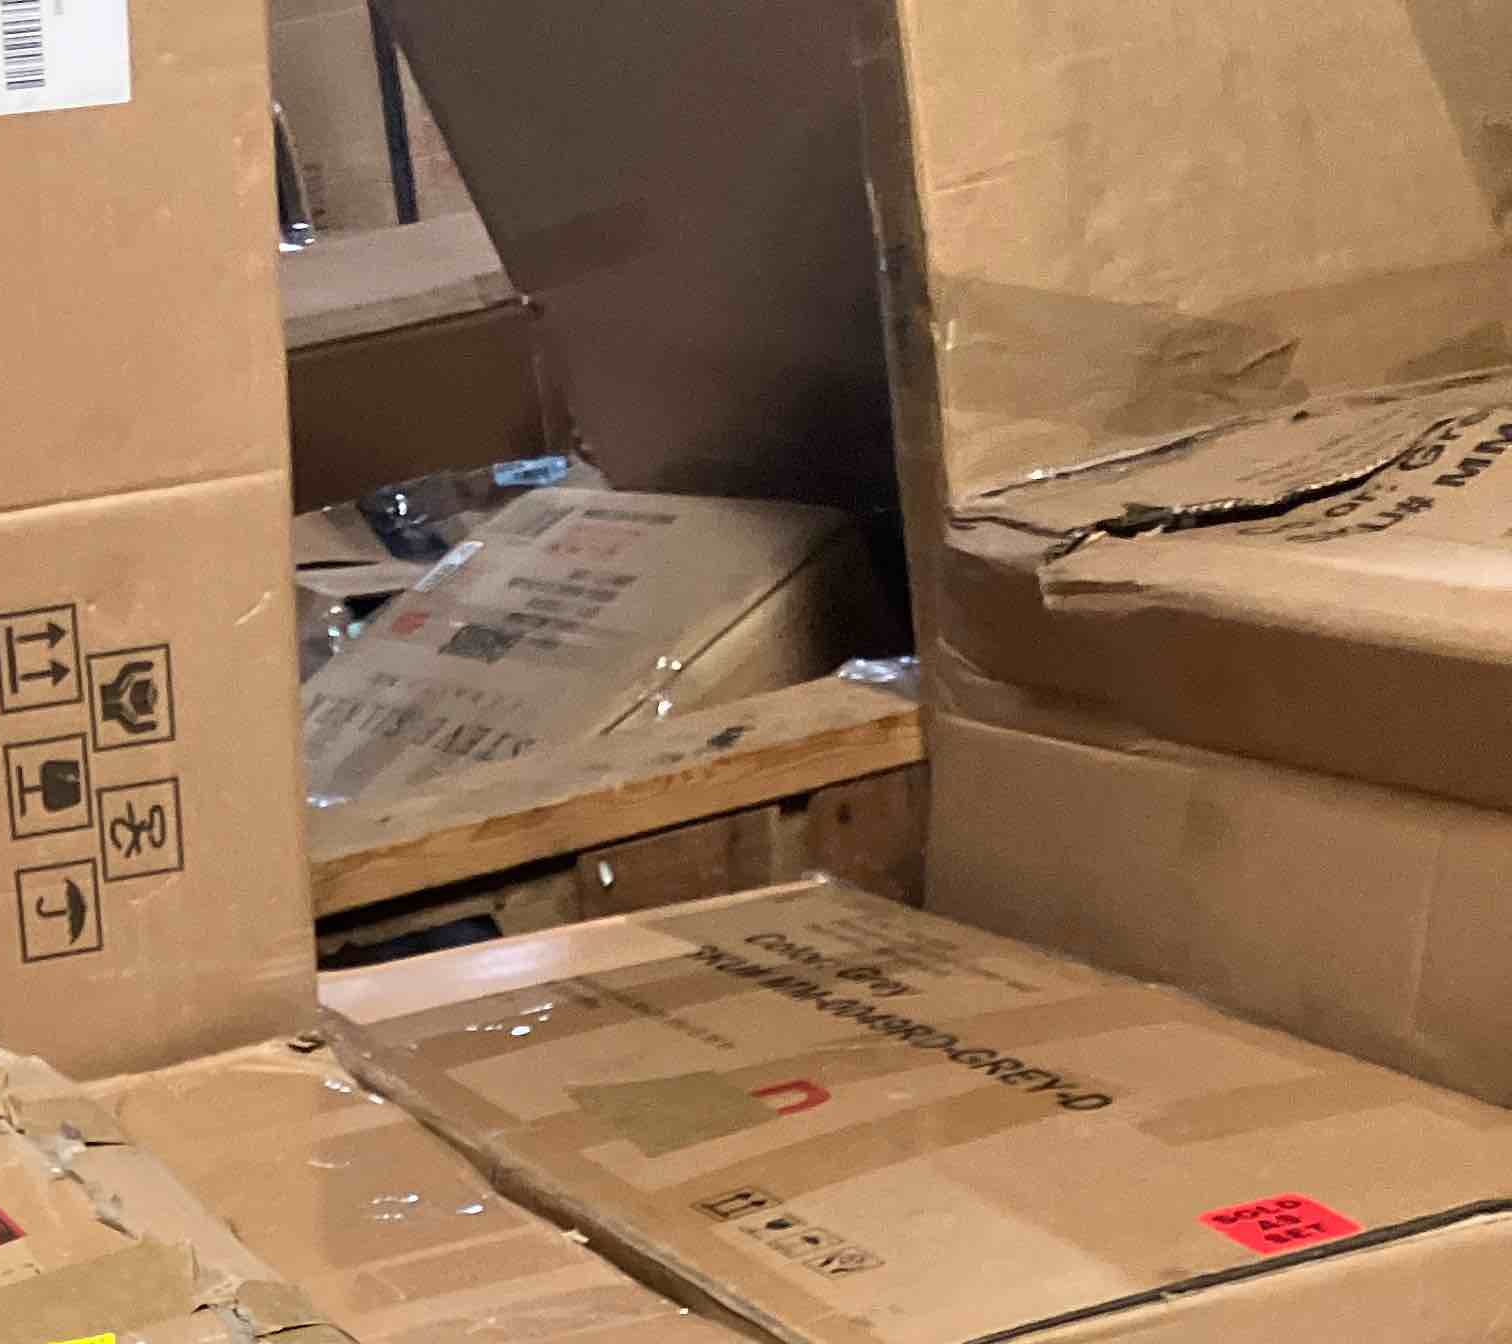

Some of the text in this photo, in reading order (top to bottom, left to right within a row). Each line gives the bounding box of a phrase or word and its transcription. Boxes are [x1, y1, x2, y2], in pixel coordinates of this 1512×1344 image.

[1211, 1199, 1303, 1225] SOLD
[1257, 1214, 1302, 1232] AS
[1263, 1223, 1326, 1244] SET
